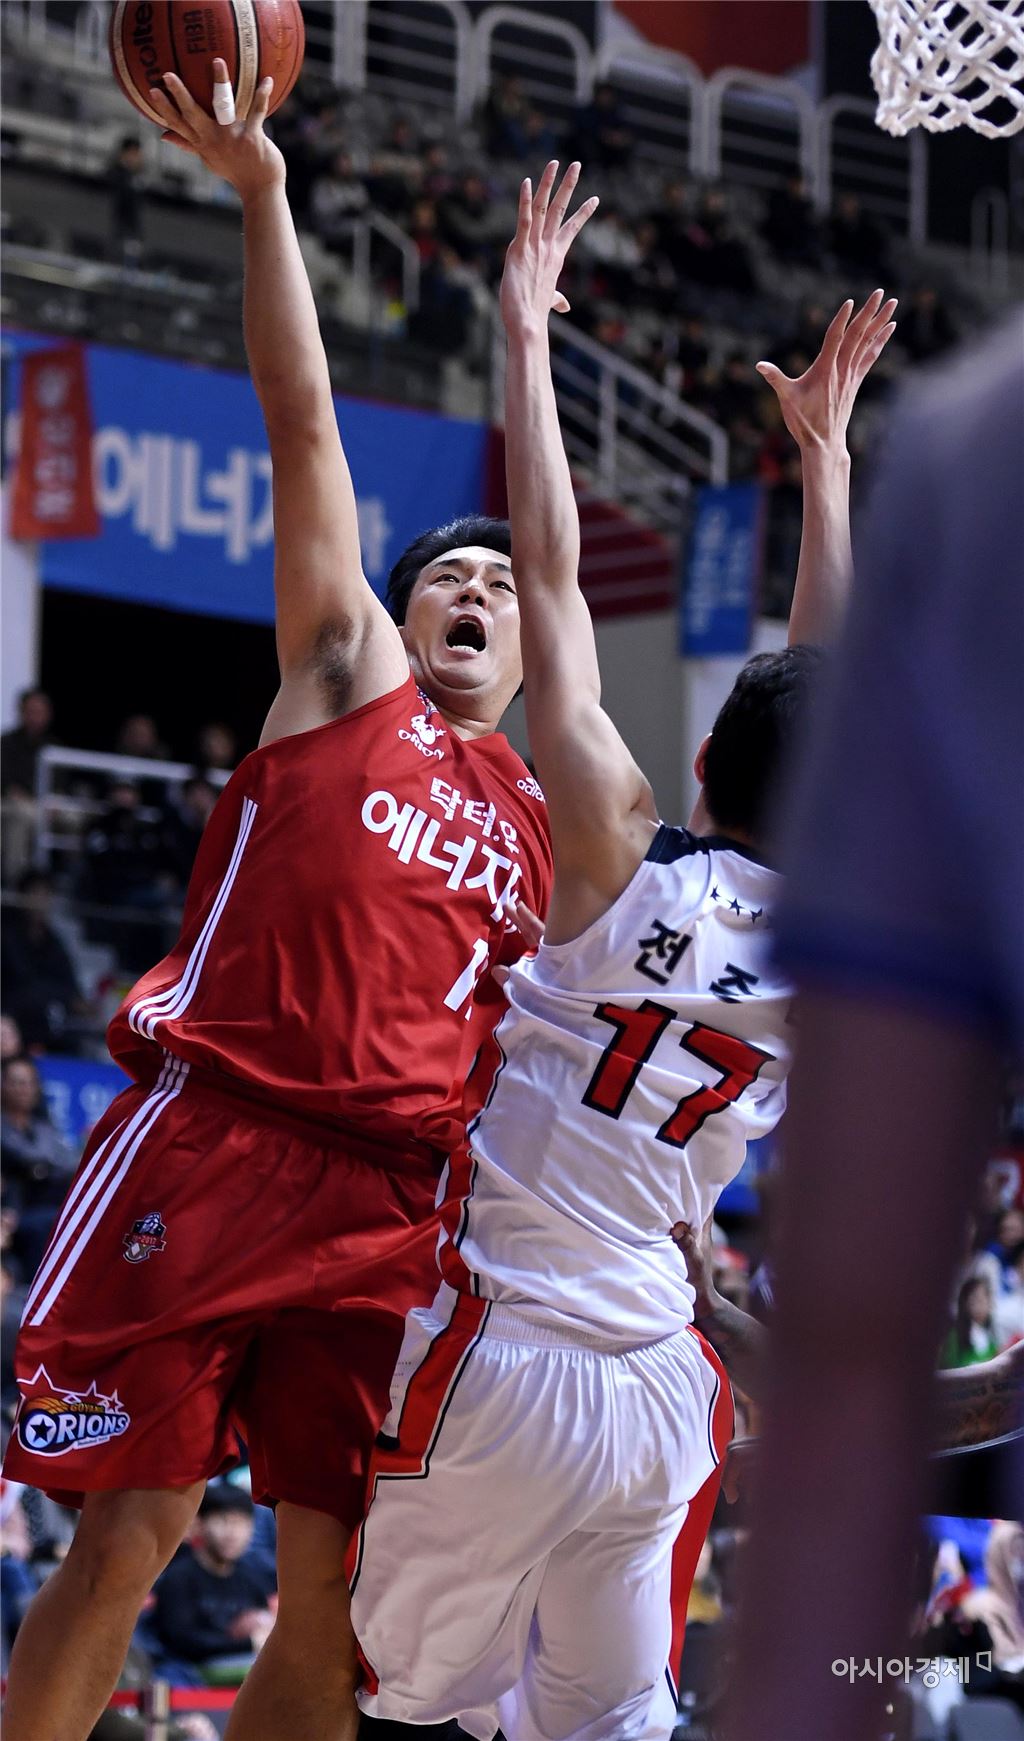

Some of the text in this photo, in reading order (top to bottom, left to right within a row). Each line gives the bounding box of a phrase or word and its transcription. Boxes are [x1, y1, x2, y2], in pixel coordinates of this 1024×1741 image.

[182, 9, 207, 54] FIBA
[398, 728, 445, 760] ORION
[581, 999, 776, 1150] 17
[25, 1413, 128, 1448] ORIONS
